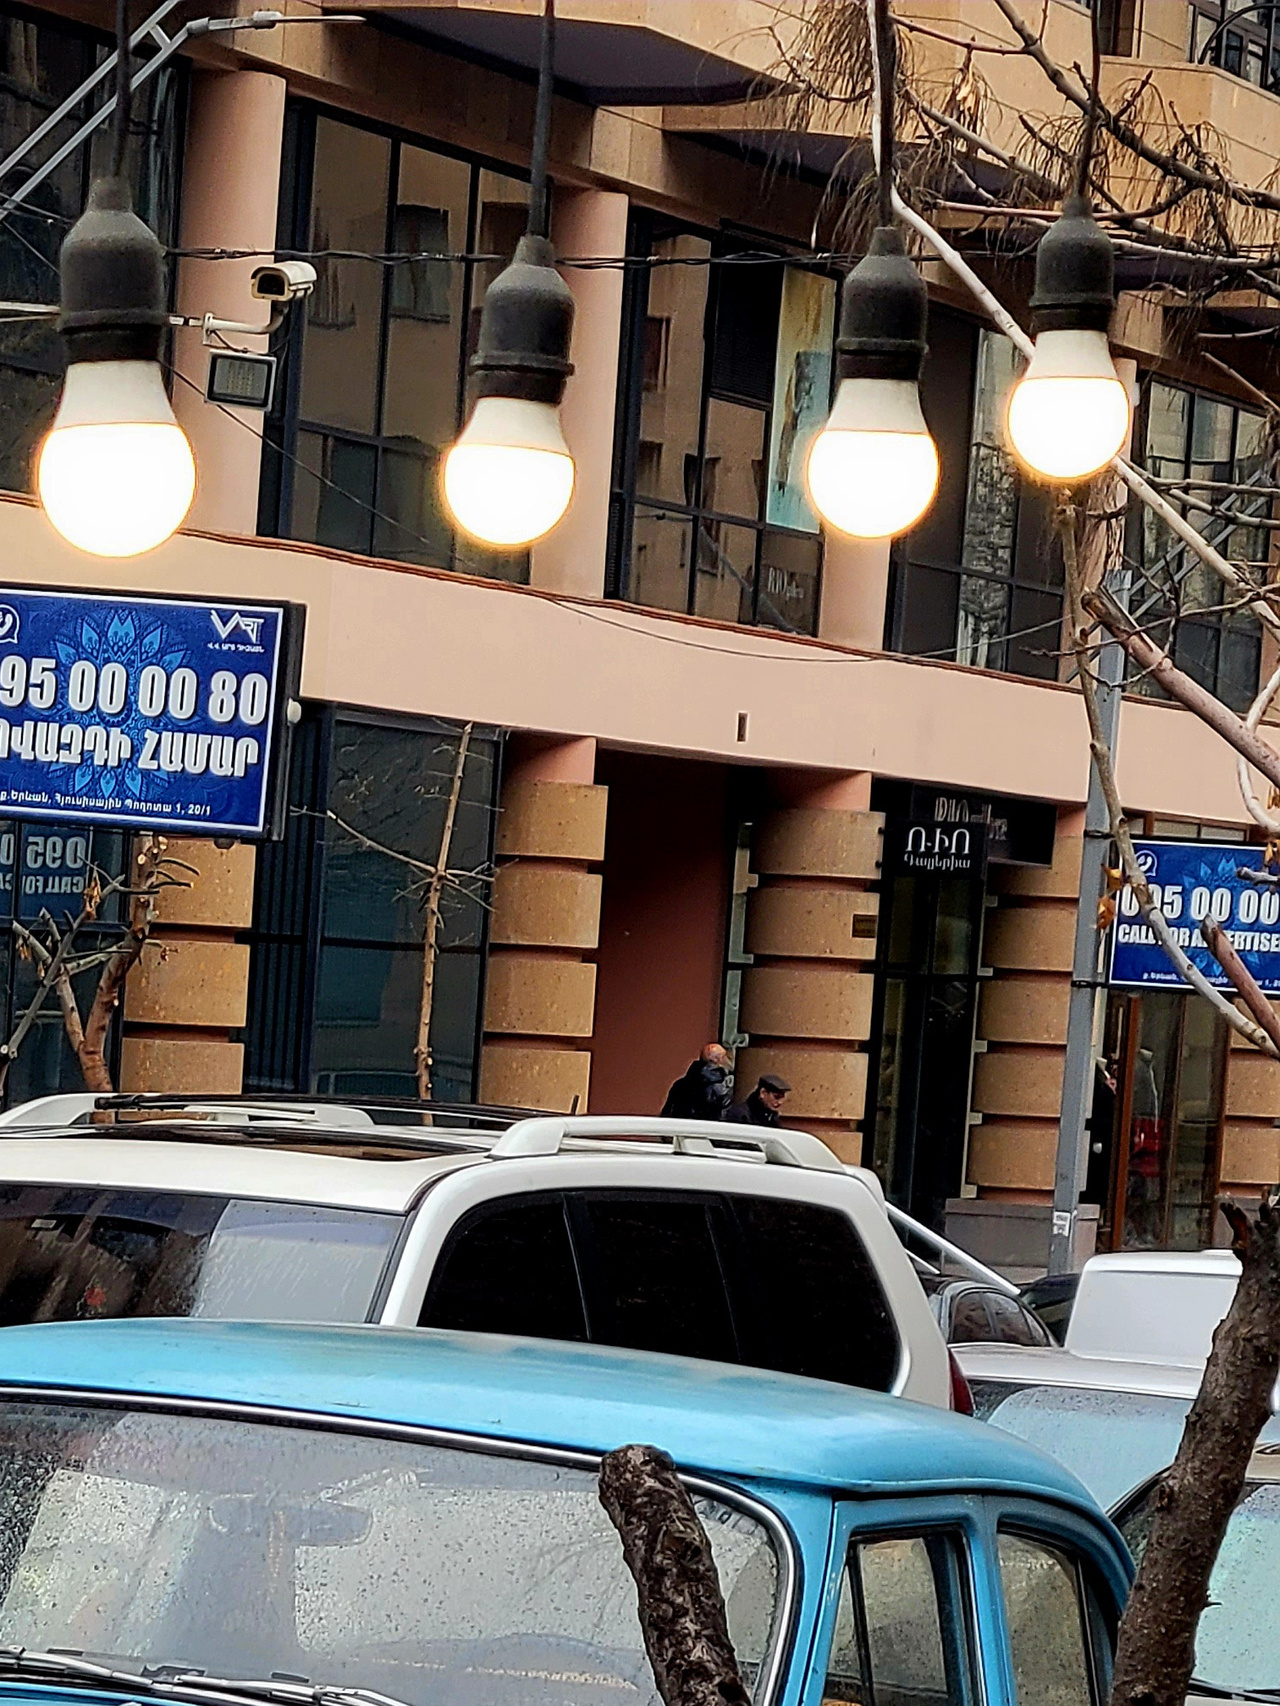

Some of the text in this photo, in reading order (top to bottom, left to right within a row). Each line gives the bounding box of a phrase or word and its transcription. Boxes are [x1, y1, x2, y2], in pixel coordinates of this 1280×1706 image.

[68, 660, 127, 714] 00
[138, 665, 198, 719] 00
[207, 670, 269, 726] 80
[137, 729, 260, 778] ՀԱՄԱՐ
[1190, 886, 1232, 922] 00
[1238, 889, 1280, 925] 00
